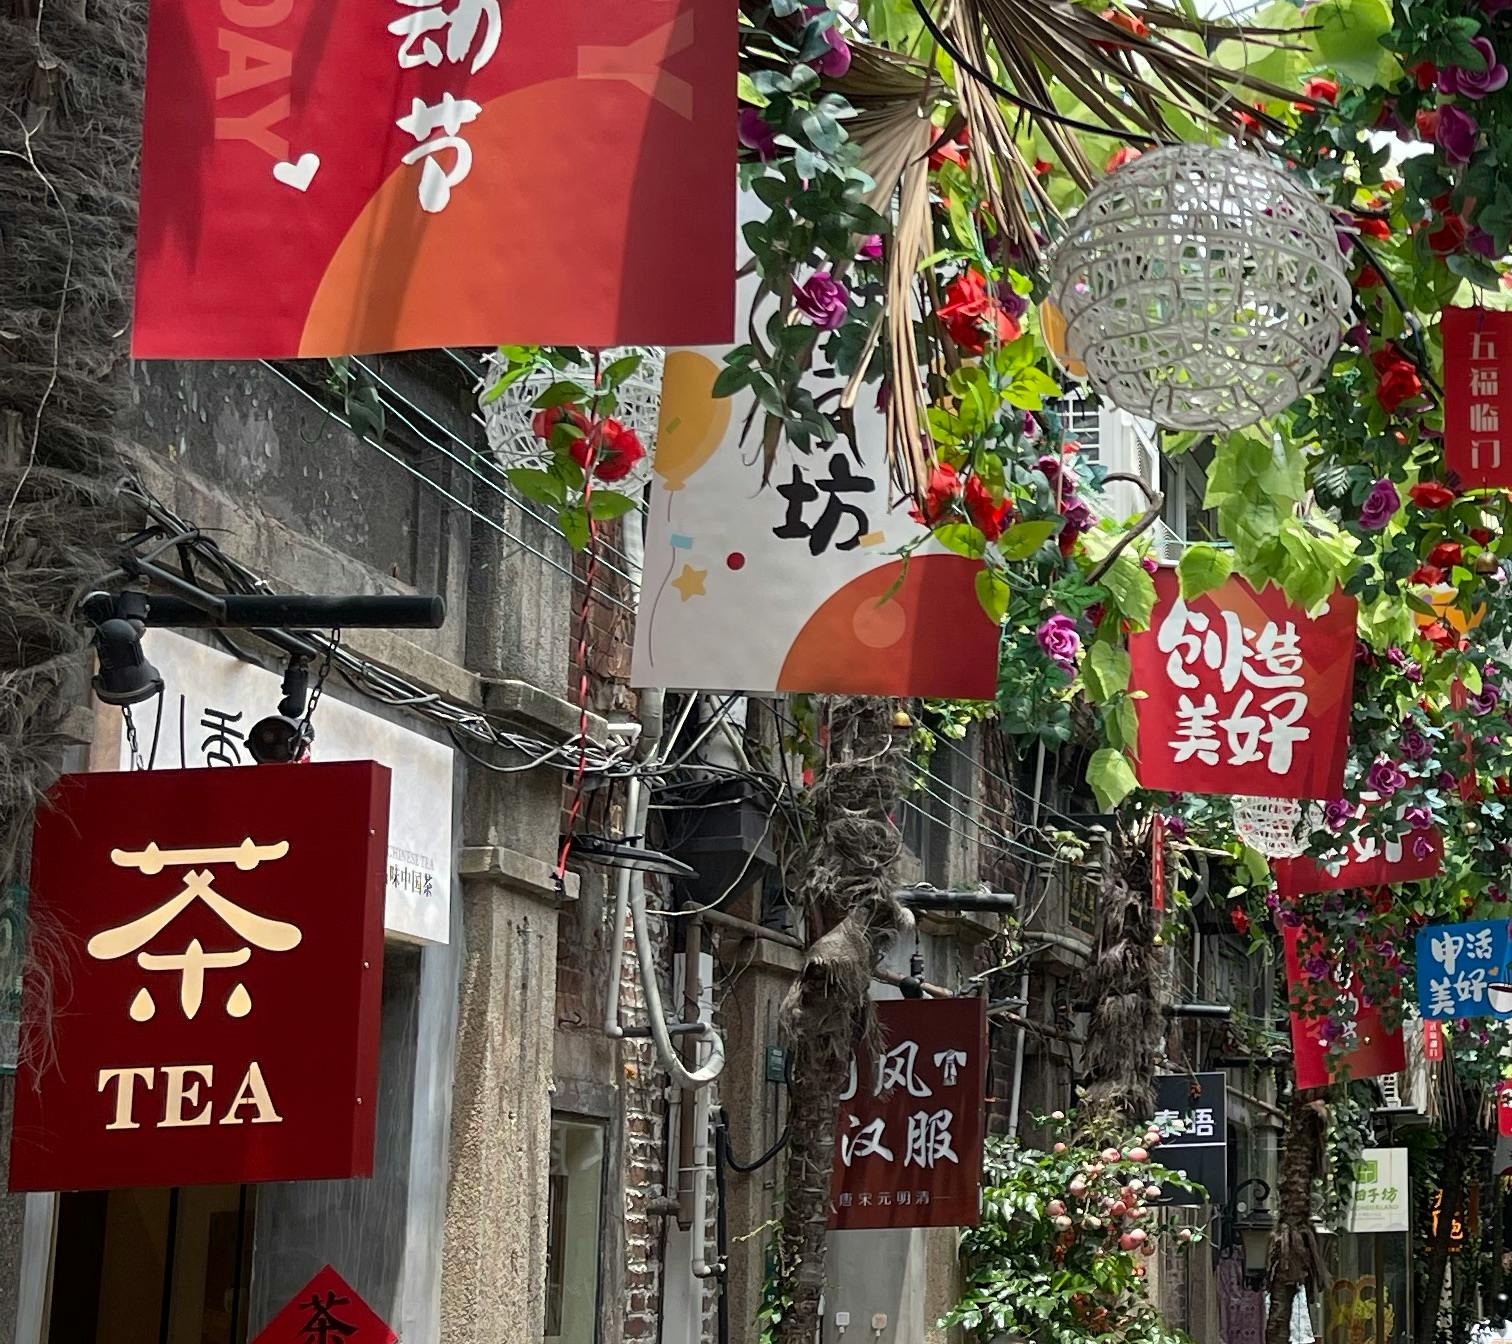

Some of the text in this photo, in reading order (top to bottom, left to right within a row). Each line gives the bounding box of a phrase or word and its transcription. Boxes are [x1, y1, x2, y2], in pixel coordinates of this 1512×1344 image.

[1468, 331, 1501, 470] 五福临门
[1168, 690, 1310, 775] 美好
[87, 837, 302, 1022] 茶
[1431, 928, 1493, 975] 申活
[1429, 968, 1488, 1016] 美好
[98, 1061, 283, 1130] TEA
[841, 1108, 960, 1170] 汉服
